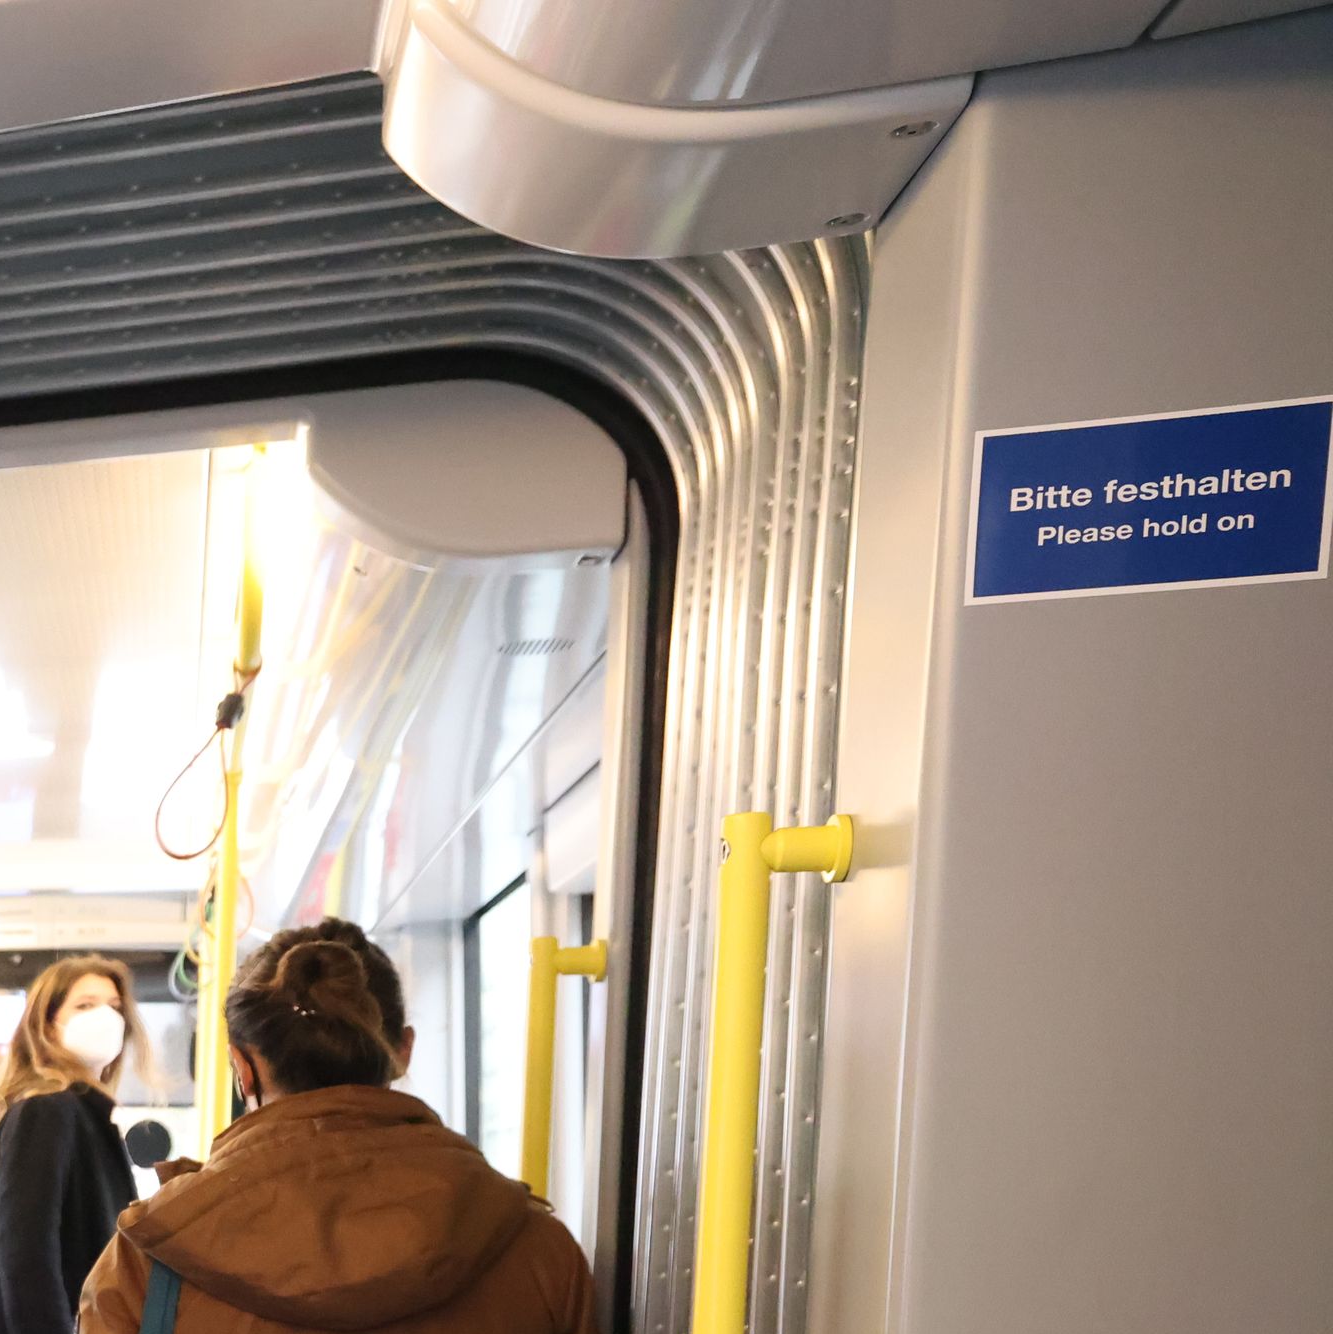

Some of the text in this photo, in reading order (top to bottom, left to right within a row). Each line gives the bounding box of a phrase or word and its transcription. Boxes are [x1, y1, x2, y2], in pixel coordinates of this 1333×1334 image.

[1009, 468, 1292, 512] Bitte festhalten
[1037, 513, 1255, 546] Please hold on
